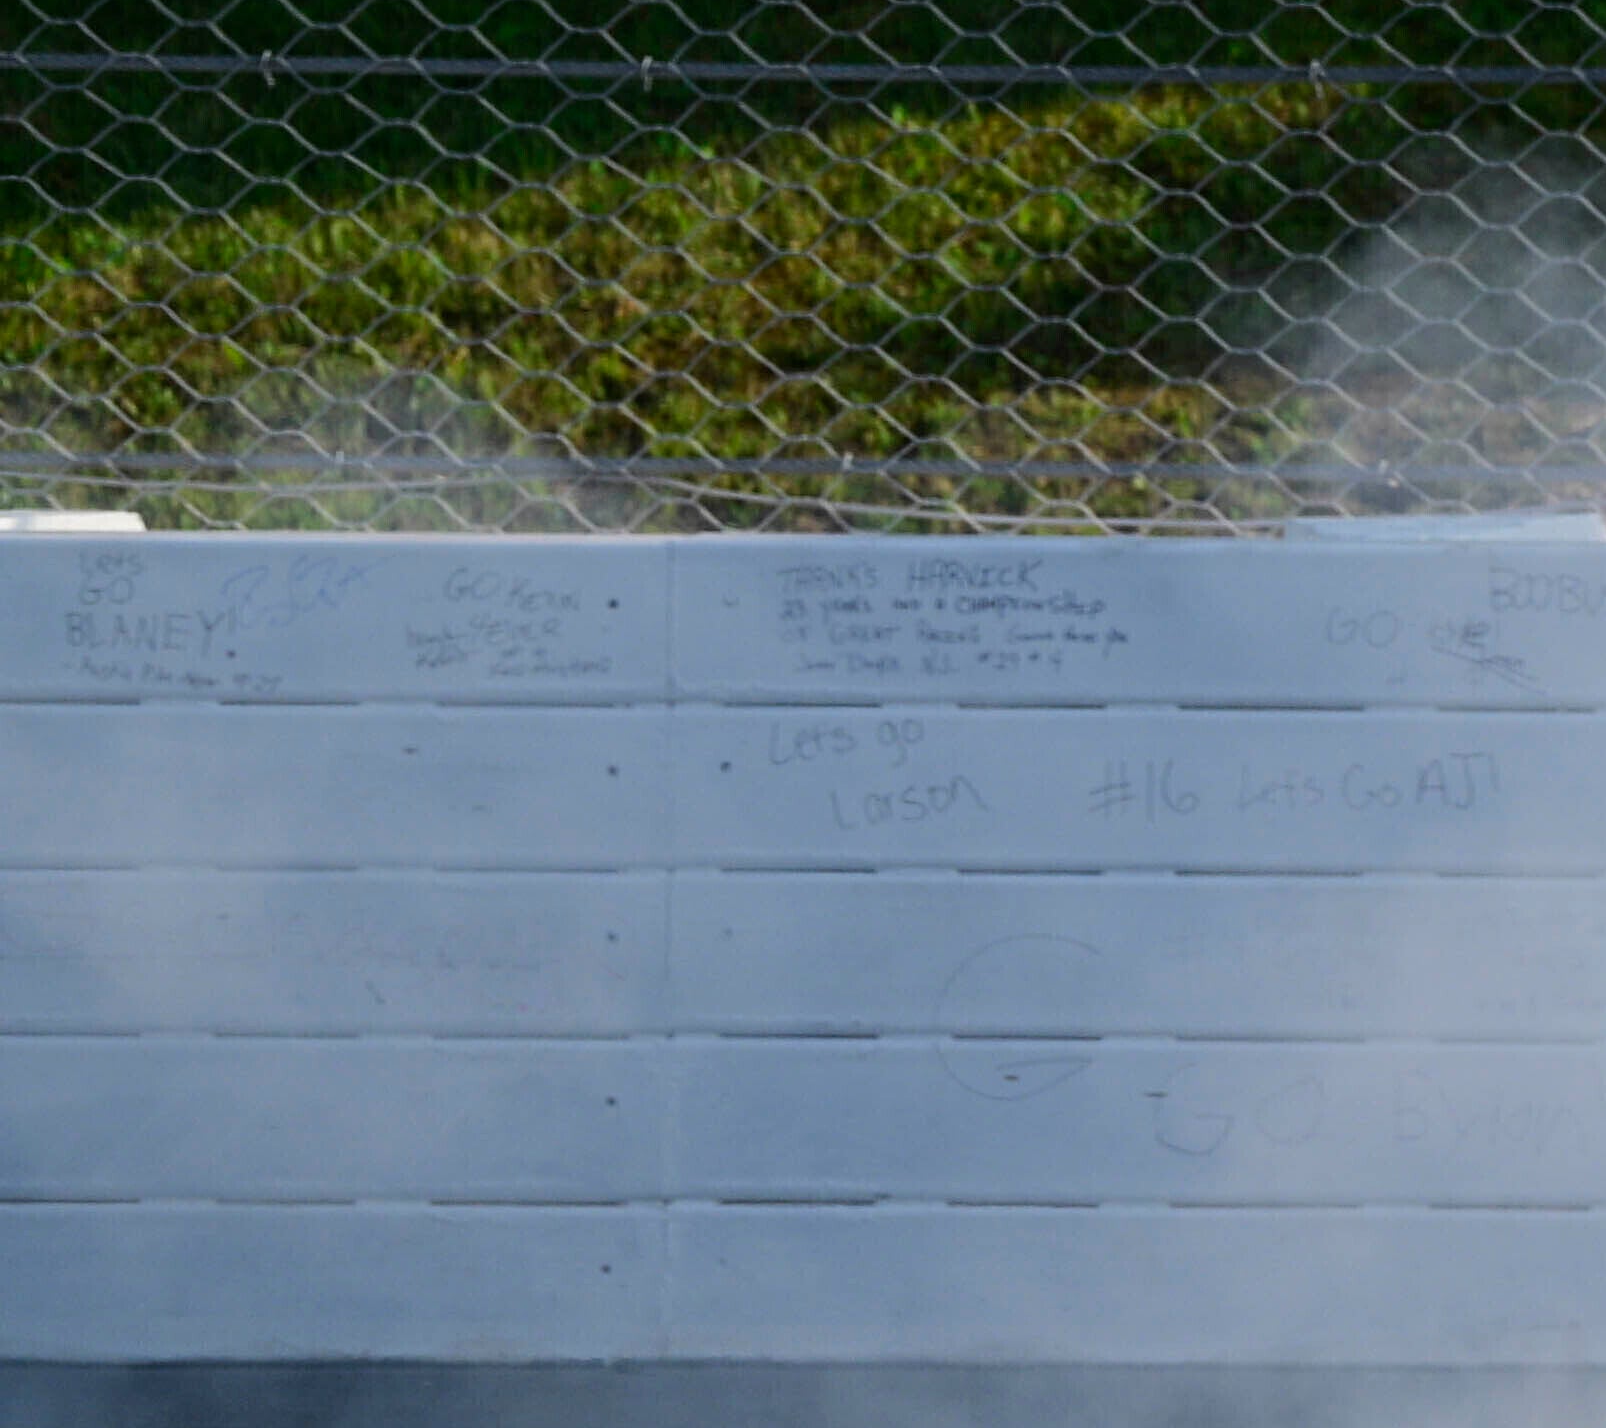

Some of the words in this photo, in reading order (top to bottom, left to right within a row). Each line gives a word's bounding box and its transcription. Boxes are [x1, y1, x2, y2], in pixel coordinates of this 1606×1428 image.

[77, 575, 136, 605] GO
[441, 565, 504, 604] GO
[906, 557, 1044, 593] HARVICK
[1323, 606, 1404, 649] GO
[1088, 757, 1201, 830] #16
